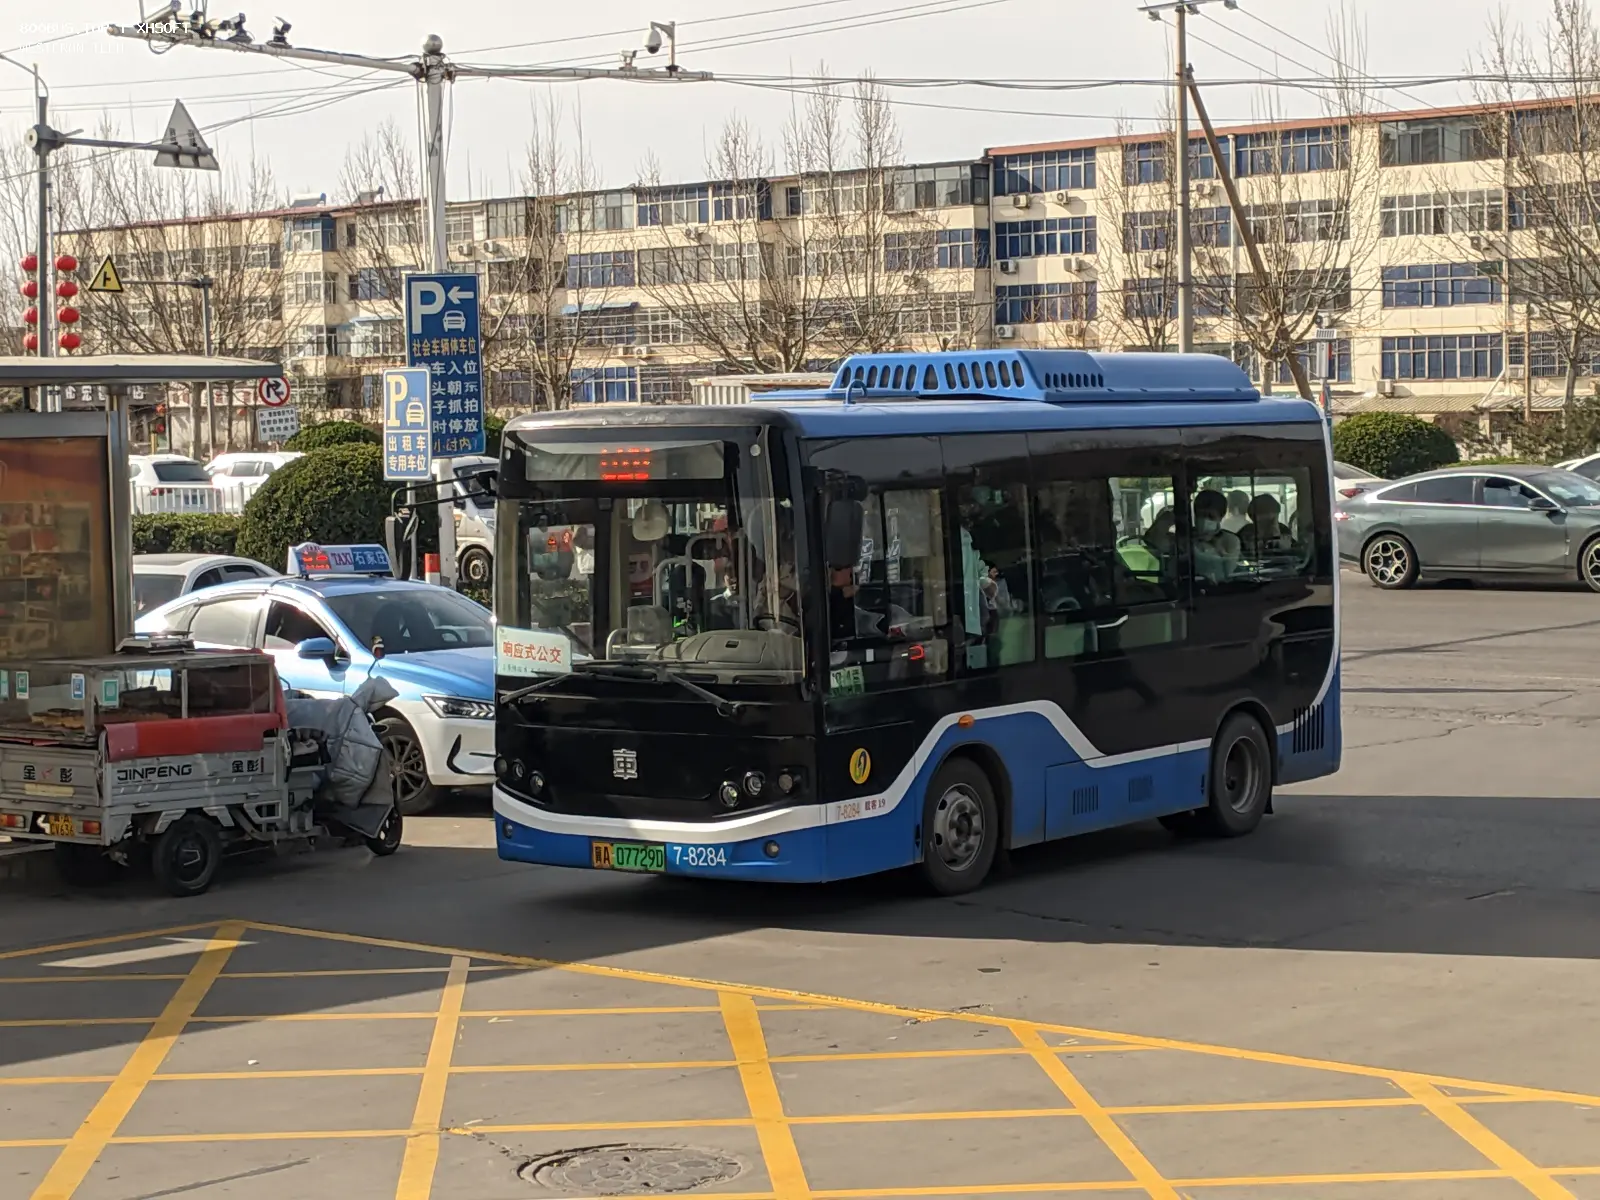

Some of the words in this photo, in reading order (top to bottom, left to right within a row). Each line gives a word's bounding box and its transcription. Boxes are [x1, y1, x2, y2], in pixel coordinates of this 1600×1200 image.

[411, 281, 446, 335] P
[412, 336, 477, 357] 社会车辆停车位
[386, 374, 408, 427] P
[432, 398, 479, 414] 子抓拍
[432, 418, 479, 434] 时停放
[388, 434, 426, 452] 出租车
[388, 454, 427, 472] 专用车位
[331, 552, 353, 566] TAXI
[503, 641, 561, 664] 响应式公交
[117, 764, 192, 781] JINPENG
[231, 760, 259, 773] 金彭
[673, 846, 727, 867] 7-8284
